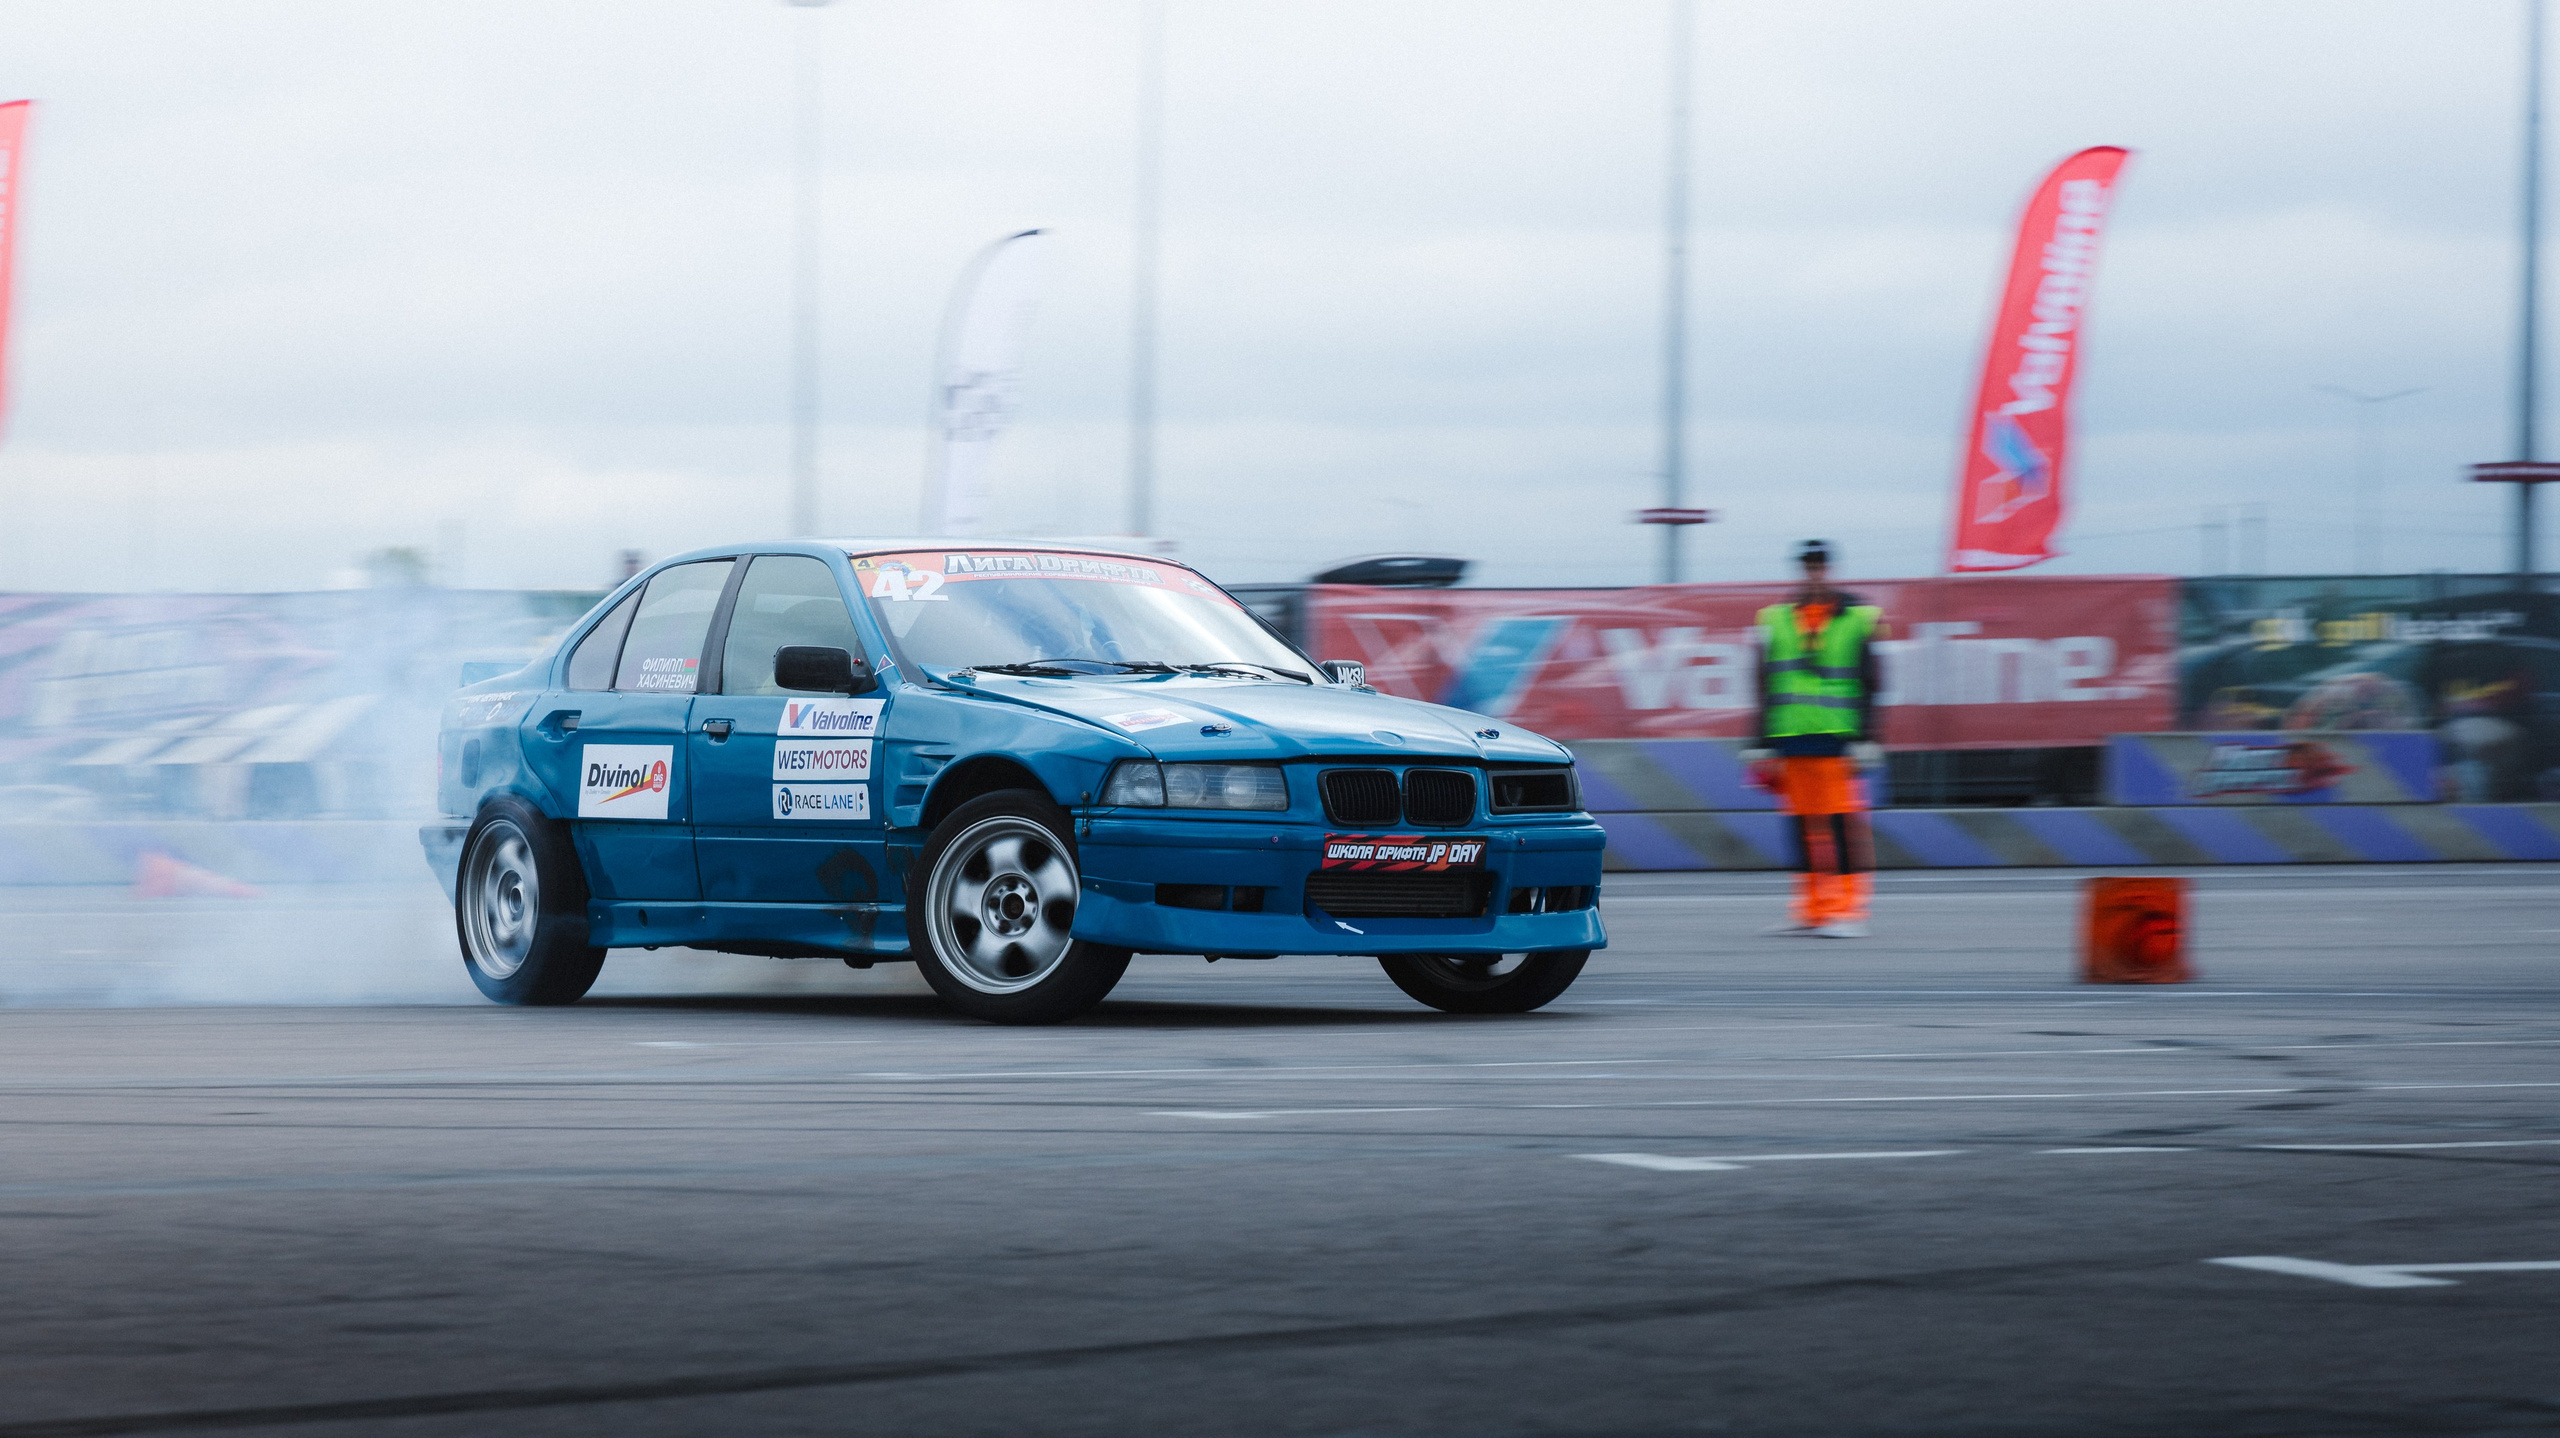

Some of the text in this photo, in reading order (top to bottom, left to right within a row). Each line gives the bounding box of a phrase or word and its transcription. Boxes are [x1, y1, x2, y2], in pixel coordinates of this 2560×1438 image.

[872, 570, 949, 601] 42
[642, 657, 683, 673] ФИЛИПП
[1601, 621, 2118, 709] Valine
[636, 673, 697, 689] ХАСИНЕВИЧ
[812, 711, 873, 730] Valvoline
[778, 749, 868, 770] WESTMOTORS
[587, 763, 648, 788] Divinol
[794, 795, 853, 809] RACE LANE
[1327, 844, 1482, 863] ШКОЛА ДРИФТА JP DAY
